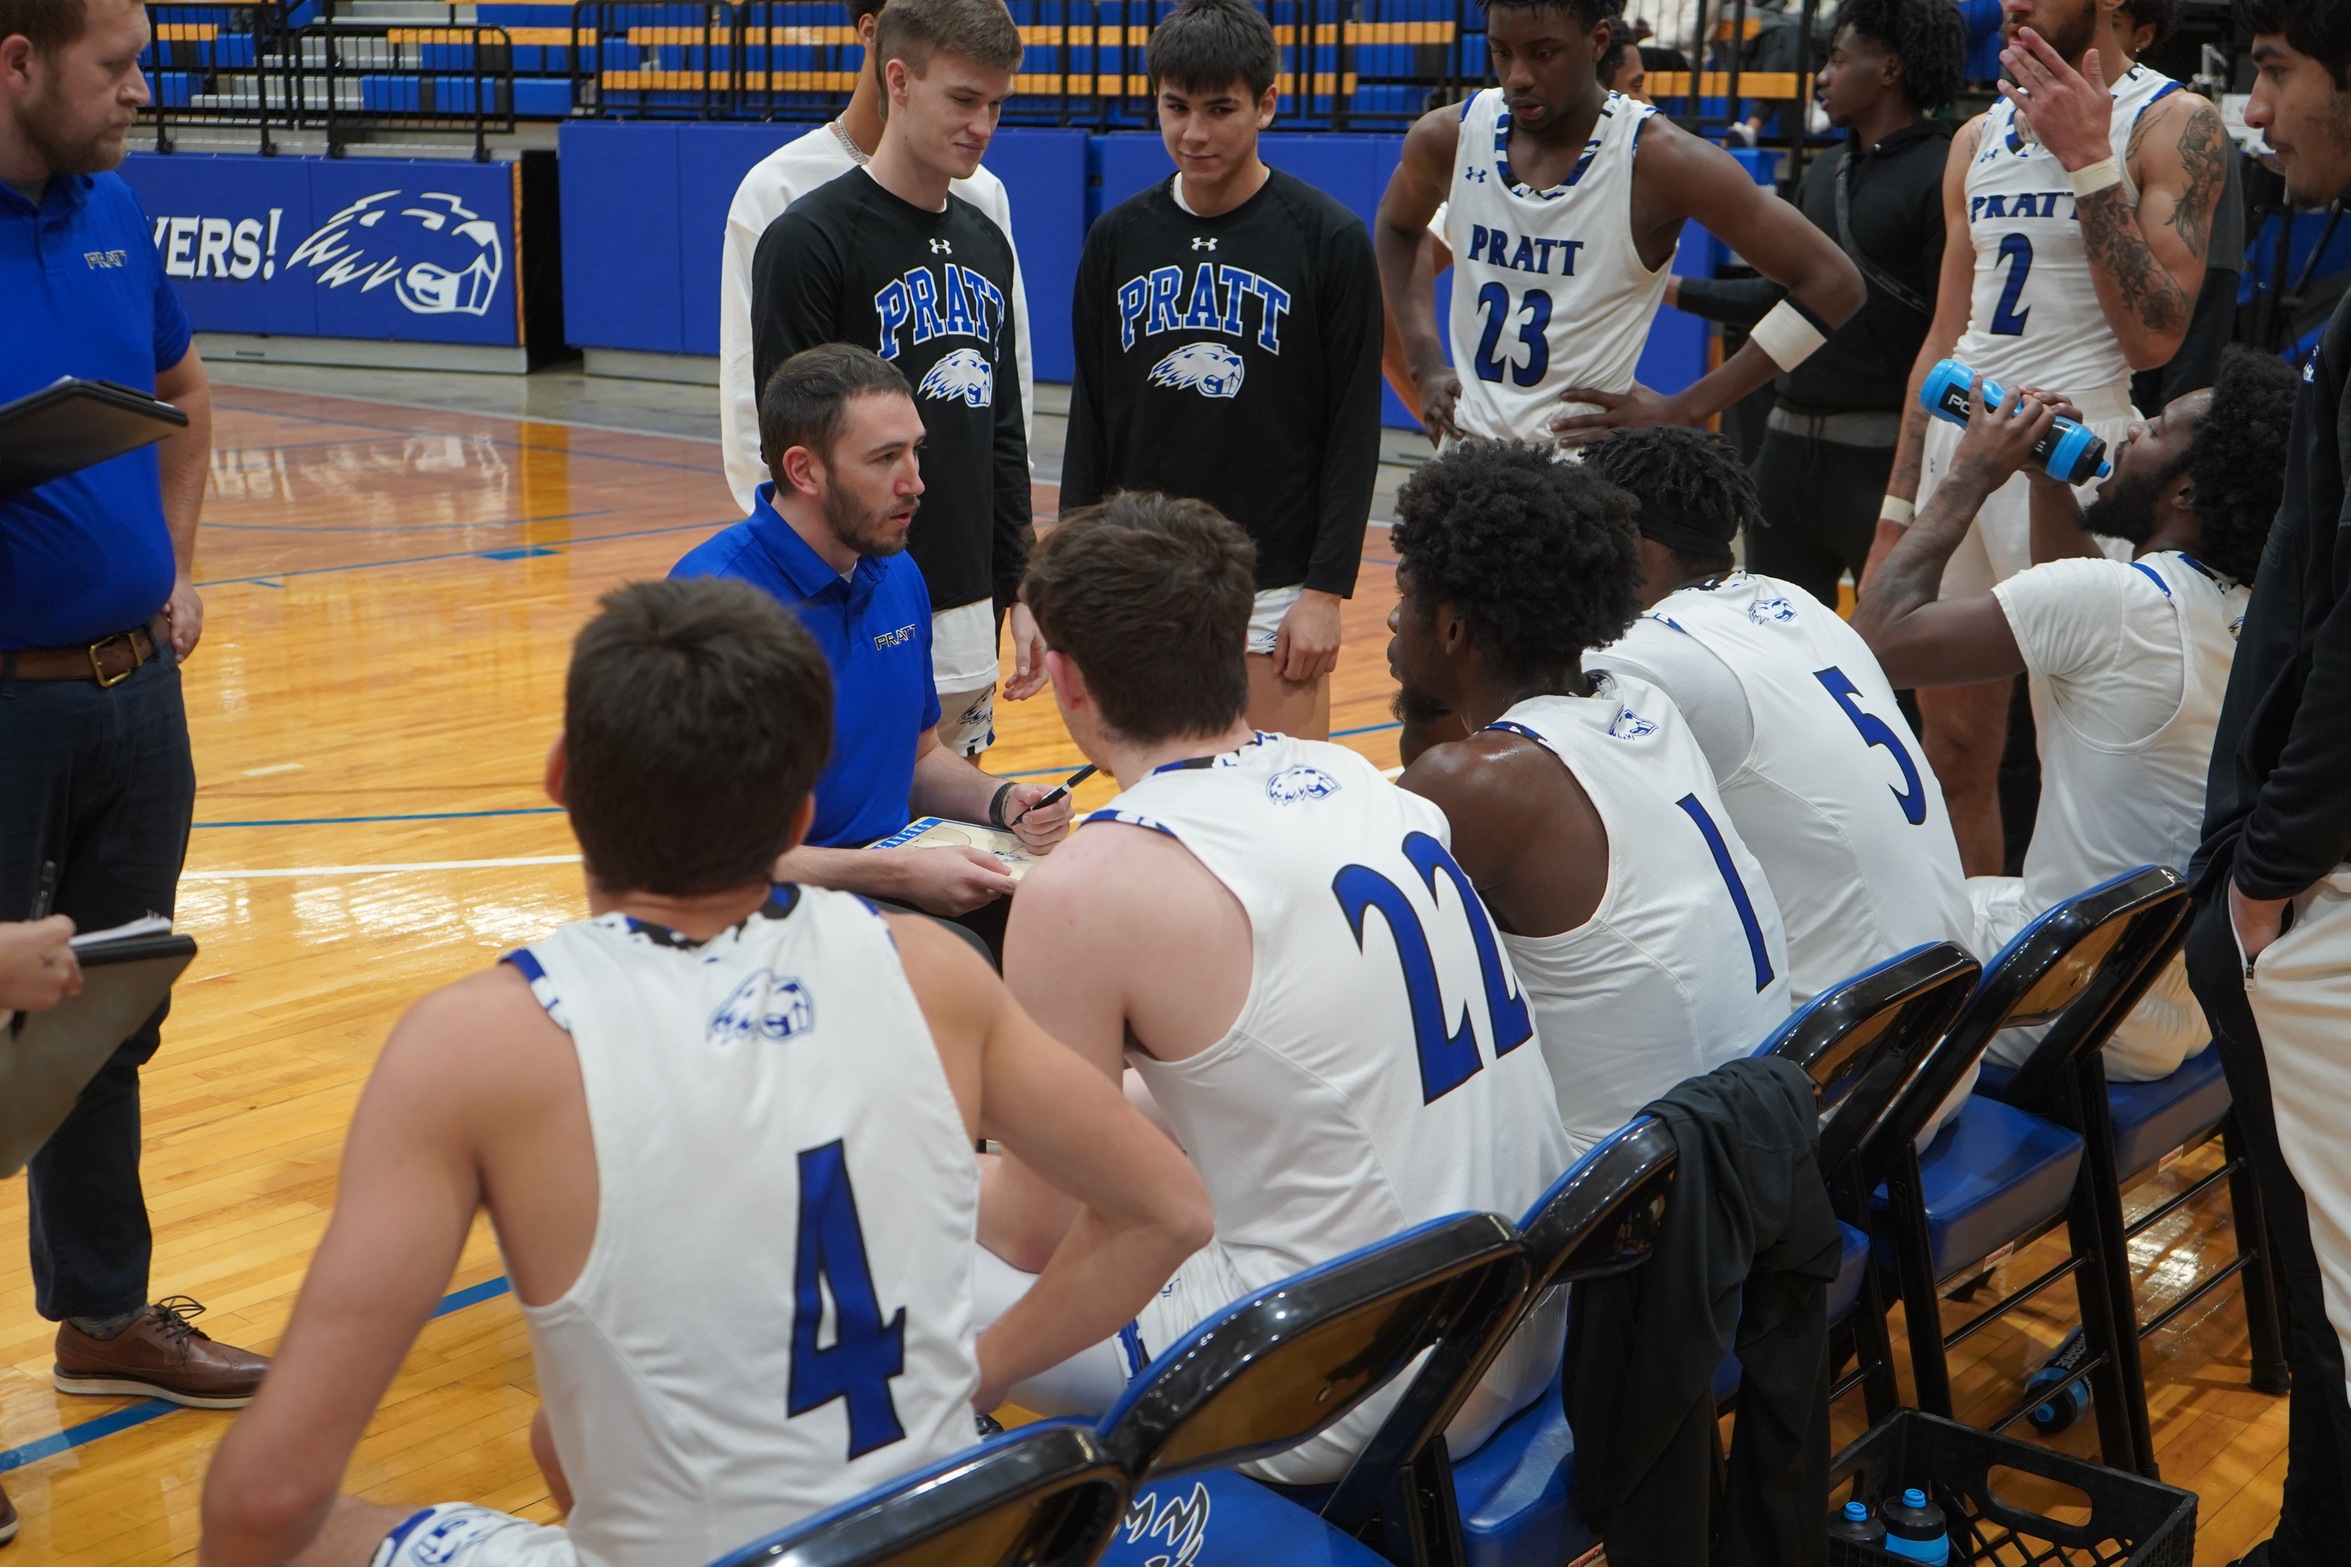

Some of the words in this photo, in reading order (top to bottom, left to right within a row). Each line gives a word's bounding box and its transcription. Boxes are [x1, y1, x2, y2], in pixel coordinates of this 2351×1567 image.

[147, 208, 283, 280] VERS!
[1468, 224, 1584, 276] PRATT
[1990, 233, 2033, 336] 2
[1117, 263, 1291, 356] PRATT
[1474, 281, 1553, 387] 23
[1812, 665, 1926, 825] 5
[876, 823, 933, 849] EAVERS
[1675, 792, 1775, 994] 1
[1331, 830, 1533, 1106] 22
[786, 1138, 907, 1462] 4
